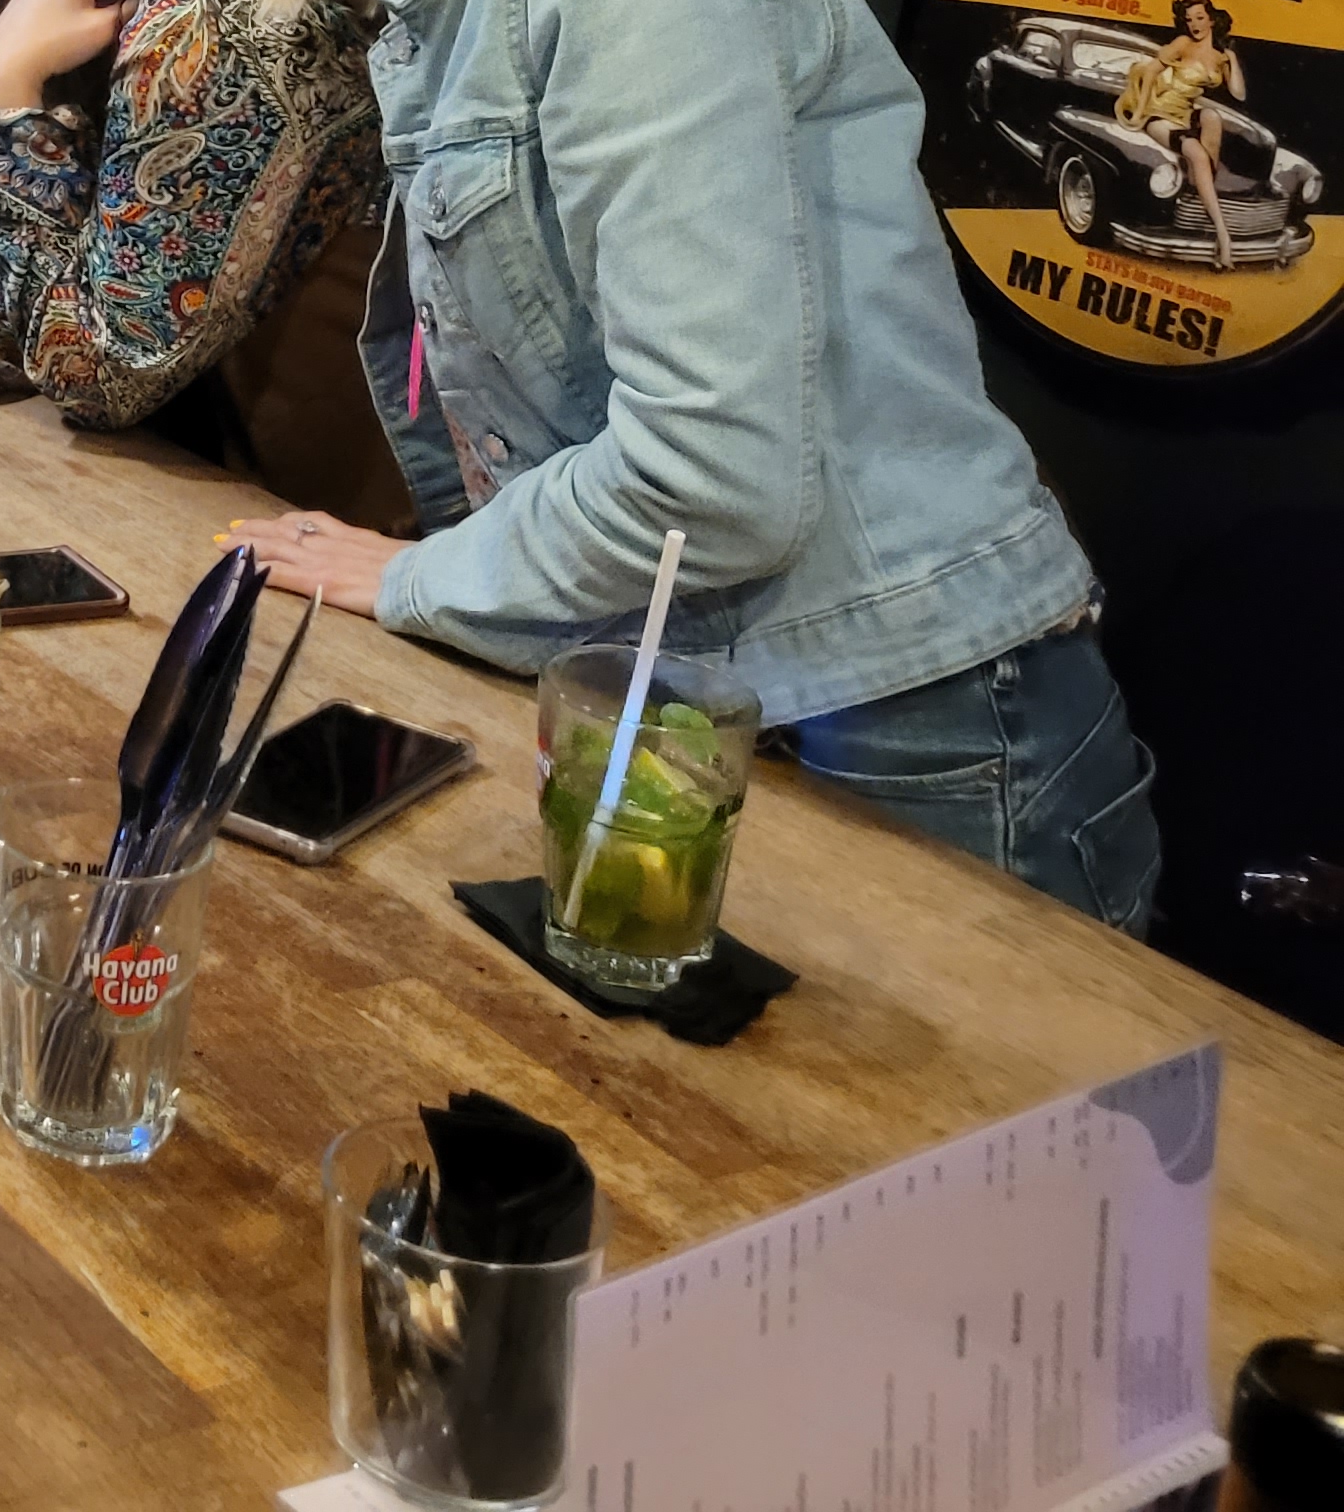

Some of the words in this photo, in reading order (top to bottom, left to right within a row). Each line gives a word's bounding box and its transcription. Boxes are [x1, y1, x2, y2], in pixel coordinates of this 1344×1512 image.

[1085, 251, 1131, 279] STAYS
[1007, 249, 1073, 302] MY
[1077, 272, 1224, 358] RULES!
[82, 952, 179, 980] Havana
[102, 980, 159, 1005] Club
